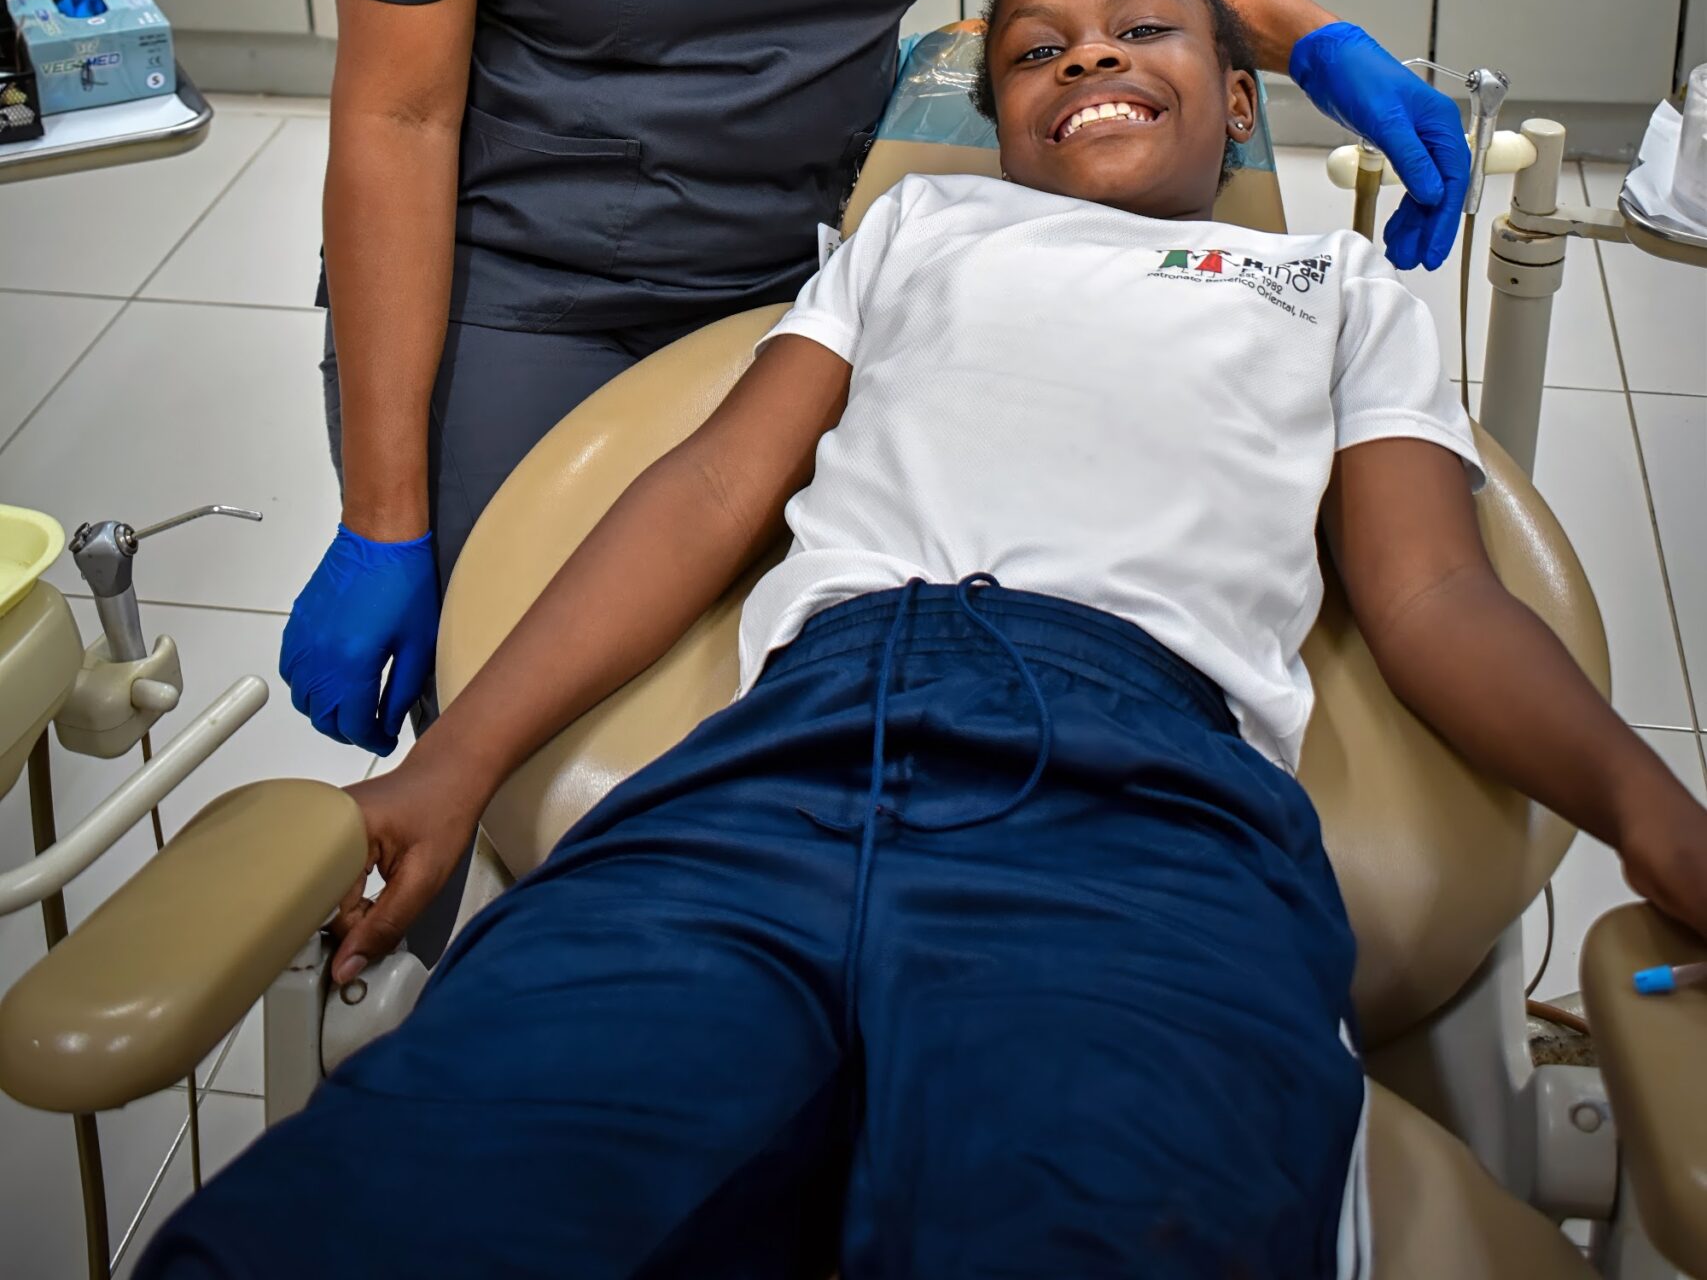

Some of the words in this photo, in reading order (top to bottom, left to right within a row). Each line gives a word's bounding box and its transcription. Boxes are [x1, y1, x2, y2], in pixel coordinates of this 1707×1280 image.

[151, 75, 160, 86] S
[1300, 267, 1325, 284] del
[1262, 276, 1283, 295] 1982
[1257, 285, 1297, 316] Oriental,
